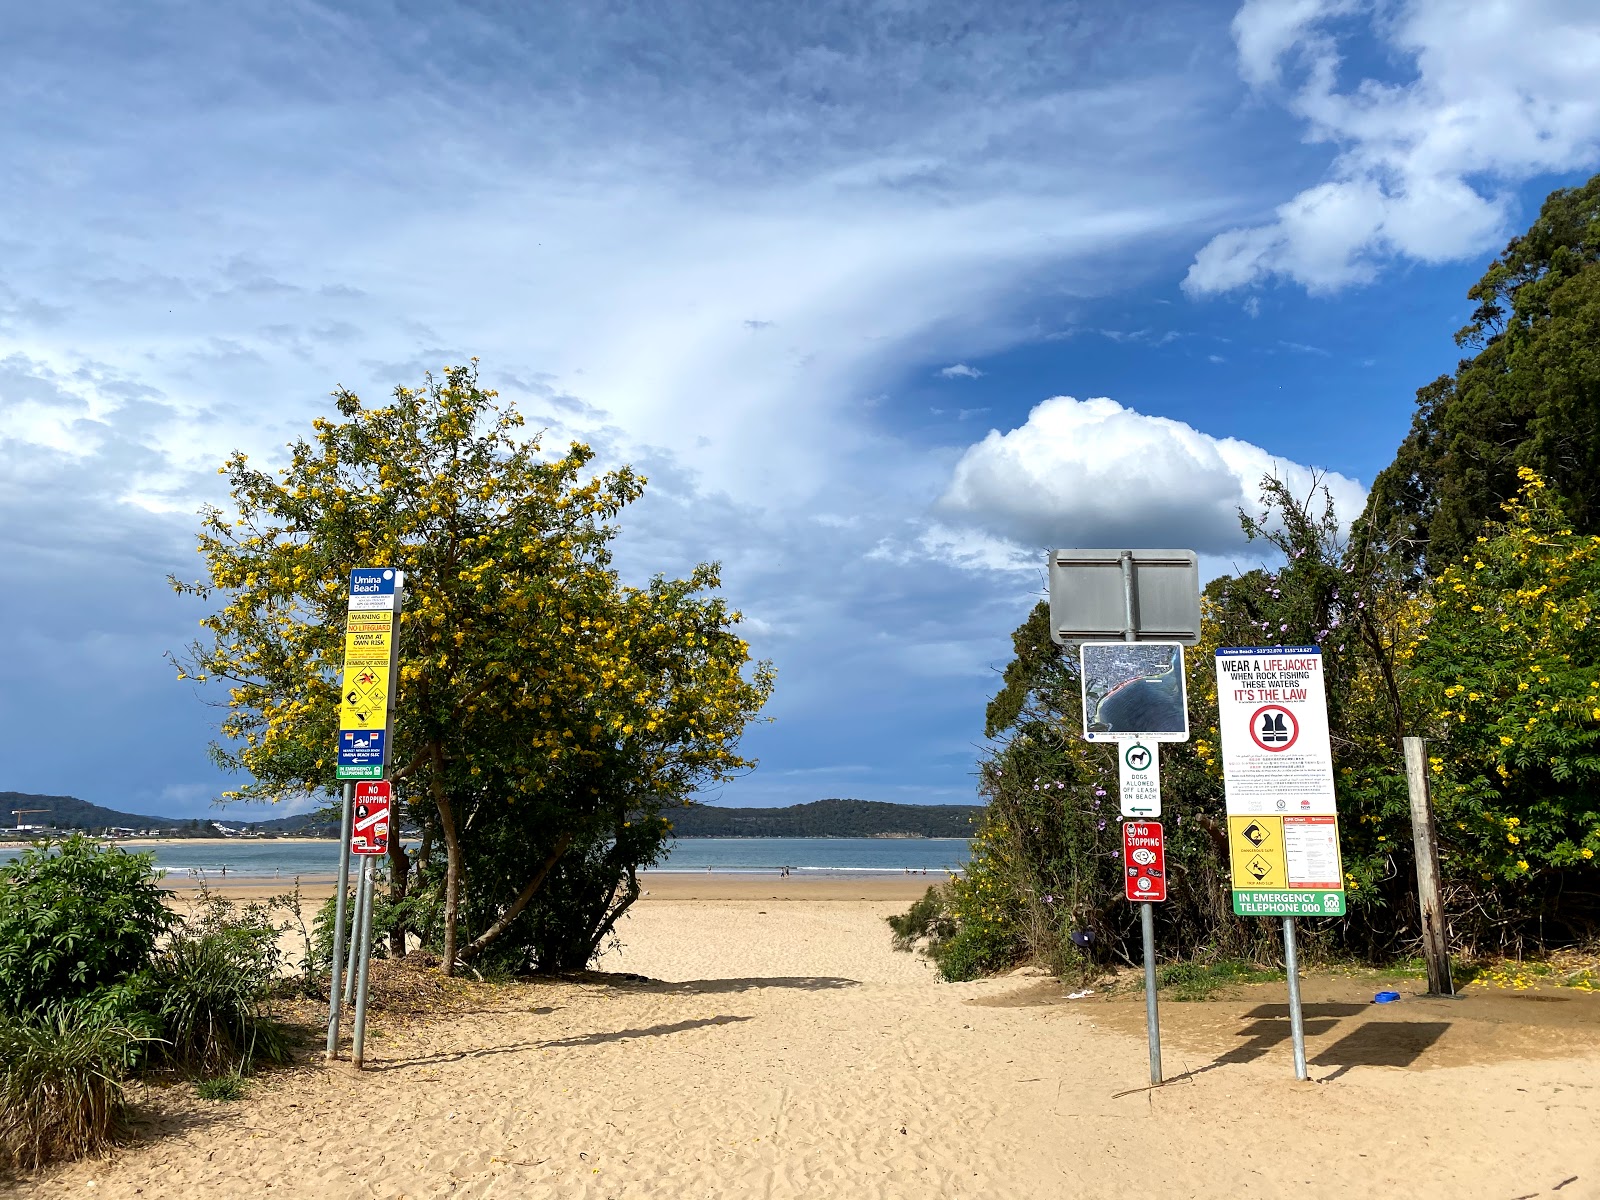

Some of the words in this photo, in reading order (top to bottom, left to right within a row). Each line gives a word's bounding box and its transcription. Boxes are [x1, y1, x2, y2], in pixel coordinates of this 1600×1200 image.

[354, 576, 381, 584] Umina
[354, 584, 379, 592] Beach
[1222, 660, 1250, 672] WEAR
[1254, 660, 1260, 672] A
[1264, 659, 1318, 671] LIFEJACKET
[1242, 680, 1266, 688] THESE
[1268, 680, 1300, 688] WATERS
[1234, 690, 1255, 701] IT'S
[1258, 689, 1280, 700] THE
[1282, 689, 1307, 700] LAW
[1128, 838, 1159, 846] STOPPING
[1239, 894, 1250, 902] IN
[1253, 894, 1316, 902] EMERGENCY
[1240, 903, 1299, 912] TELEPHONE
[1302, 904, 1320, 912] 000
